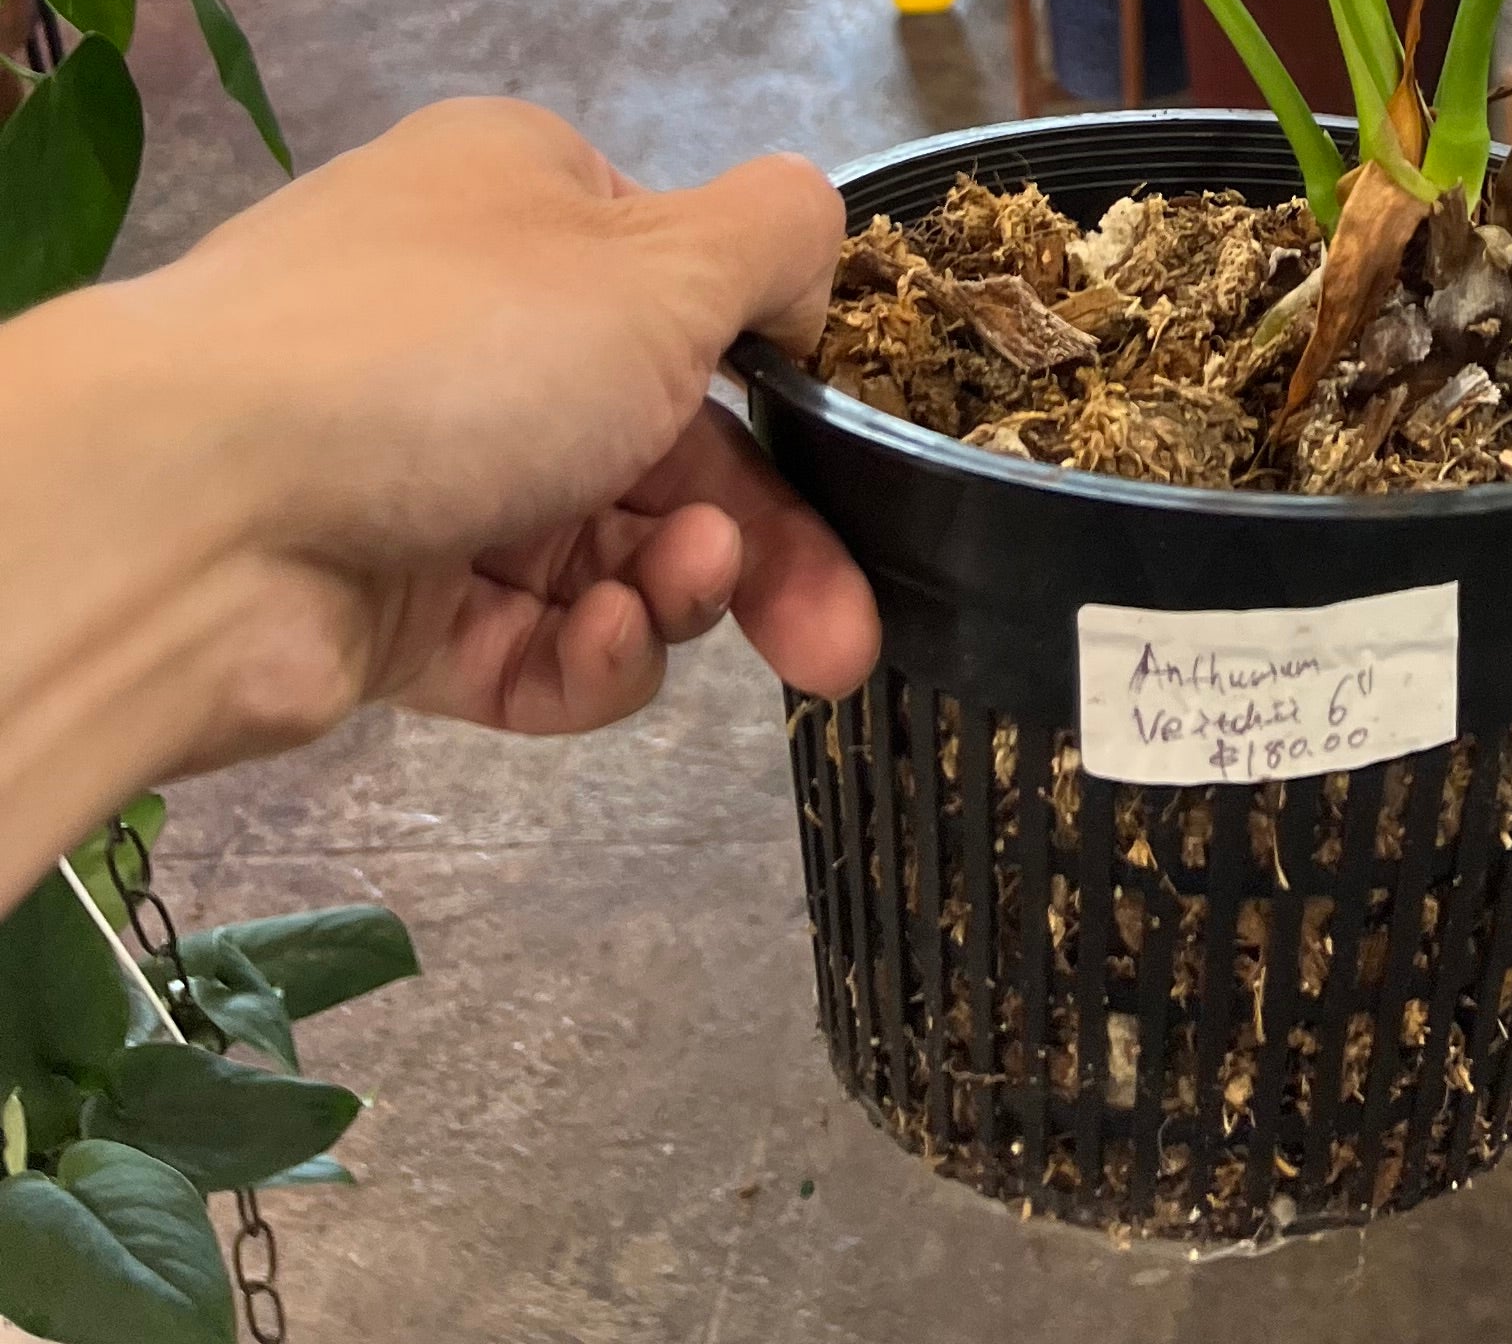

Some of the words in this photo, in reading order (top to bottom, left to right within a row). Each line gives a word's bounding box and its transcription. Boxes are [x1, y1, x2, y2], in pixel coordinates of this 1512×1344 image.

[1128, 642, 1320, 695] Anthurium
[1327, 664, 1374, 726] 6"
[1209, 727, 1368, 779] $180.00
